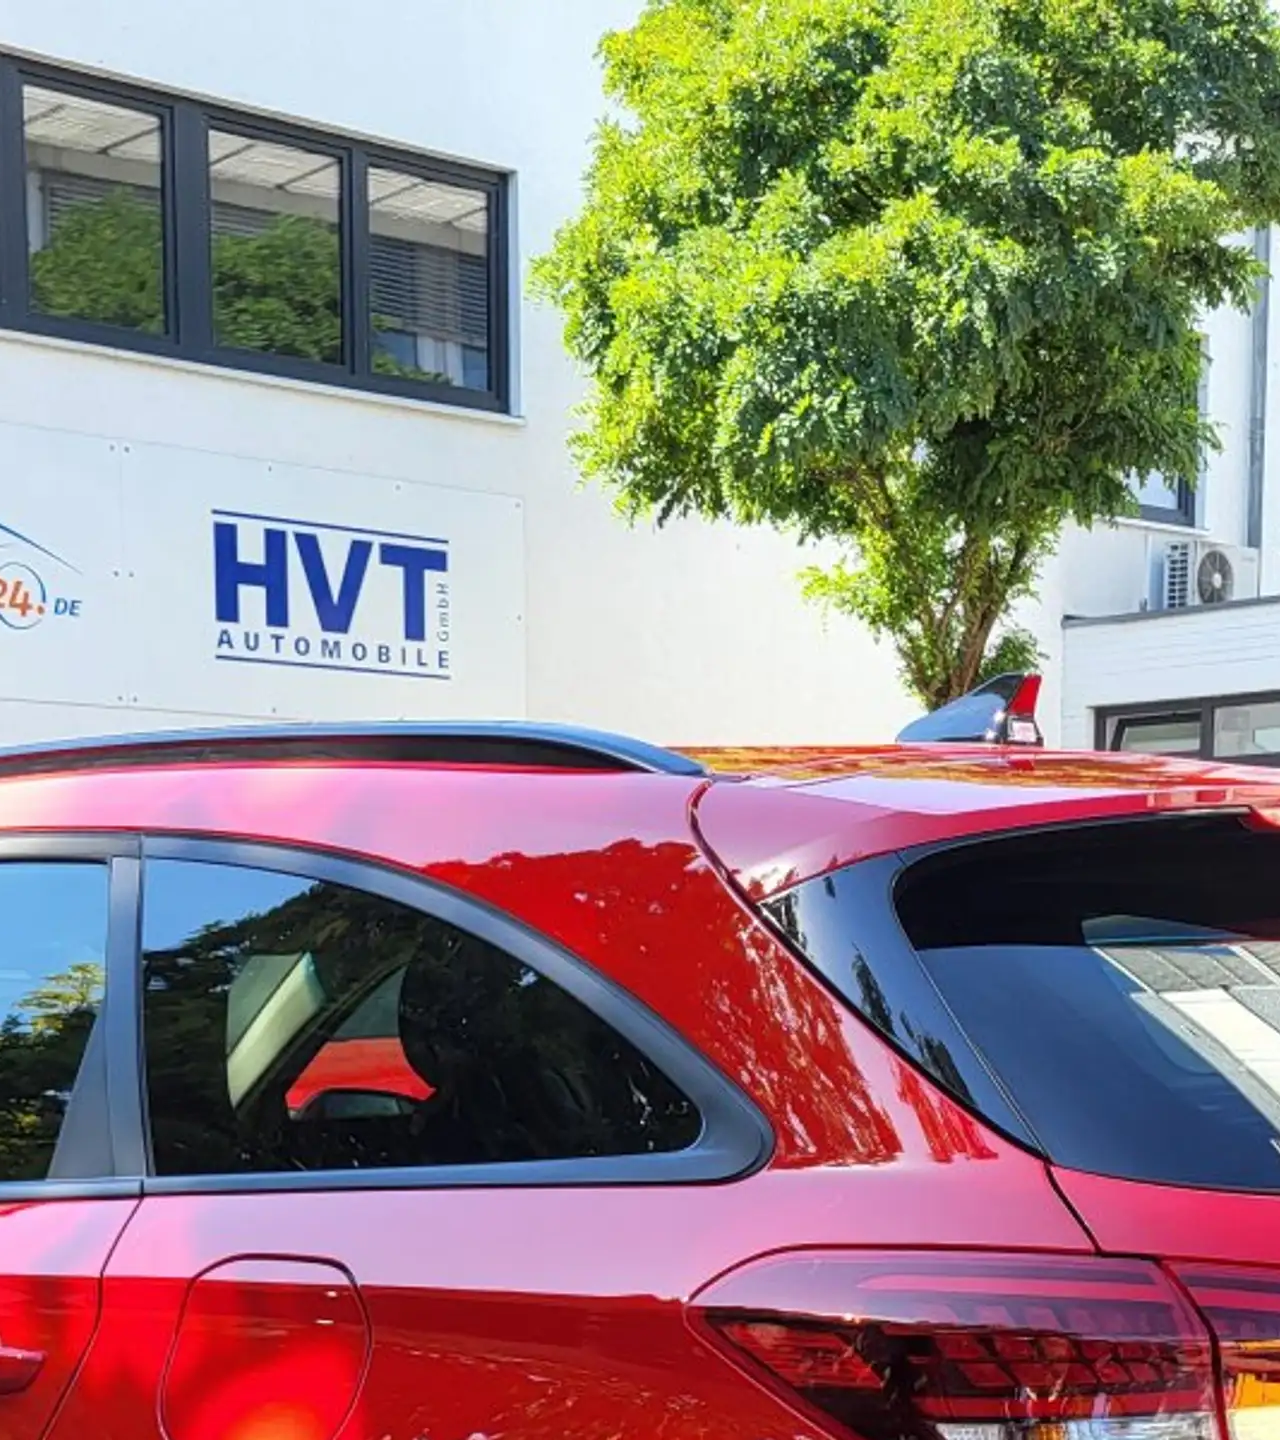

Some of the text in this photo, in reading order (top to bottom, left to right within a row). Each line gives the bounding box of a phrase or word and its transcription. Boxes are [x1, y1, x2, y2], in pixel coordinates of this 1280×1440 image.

[213, 520, 448, 642] HVT
[435, 582, 450, 642] GmbH
[216, 629, 450, 669] AUTOMOBILE
